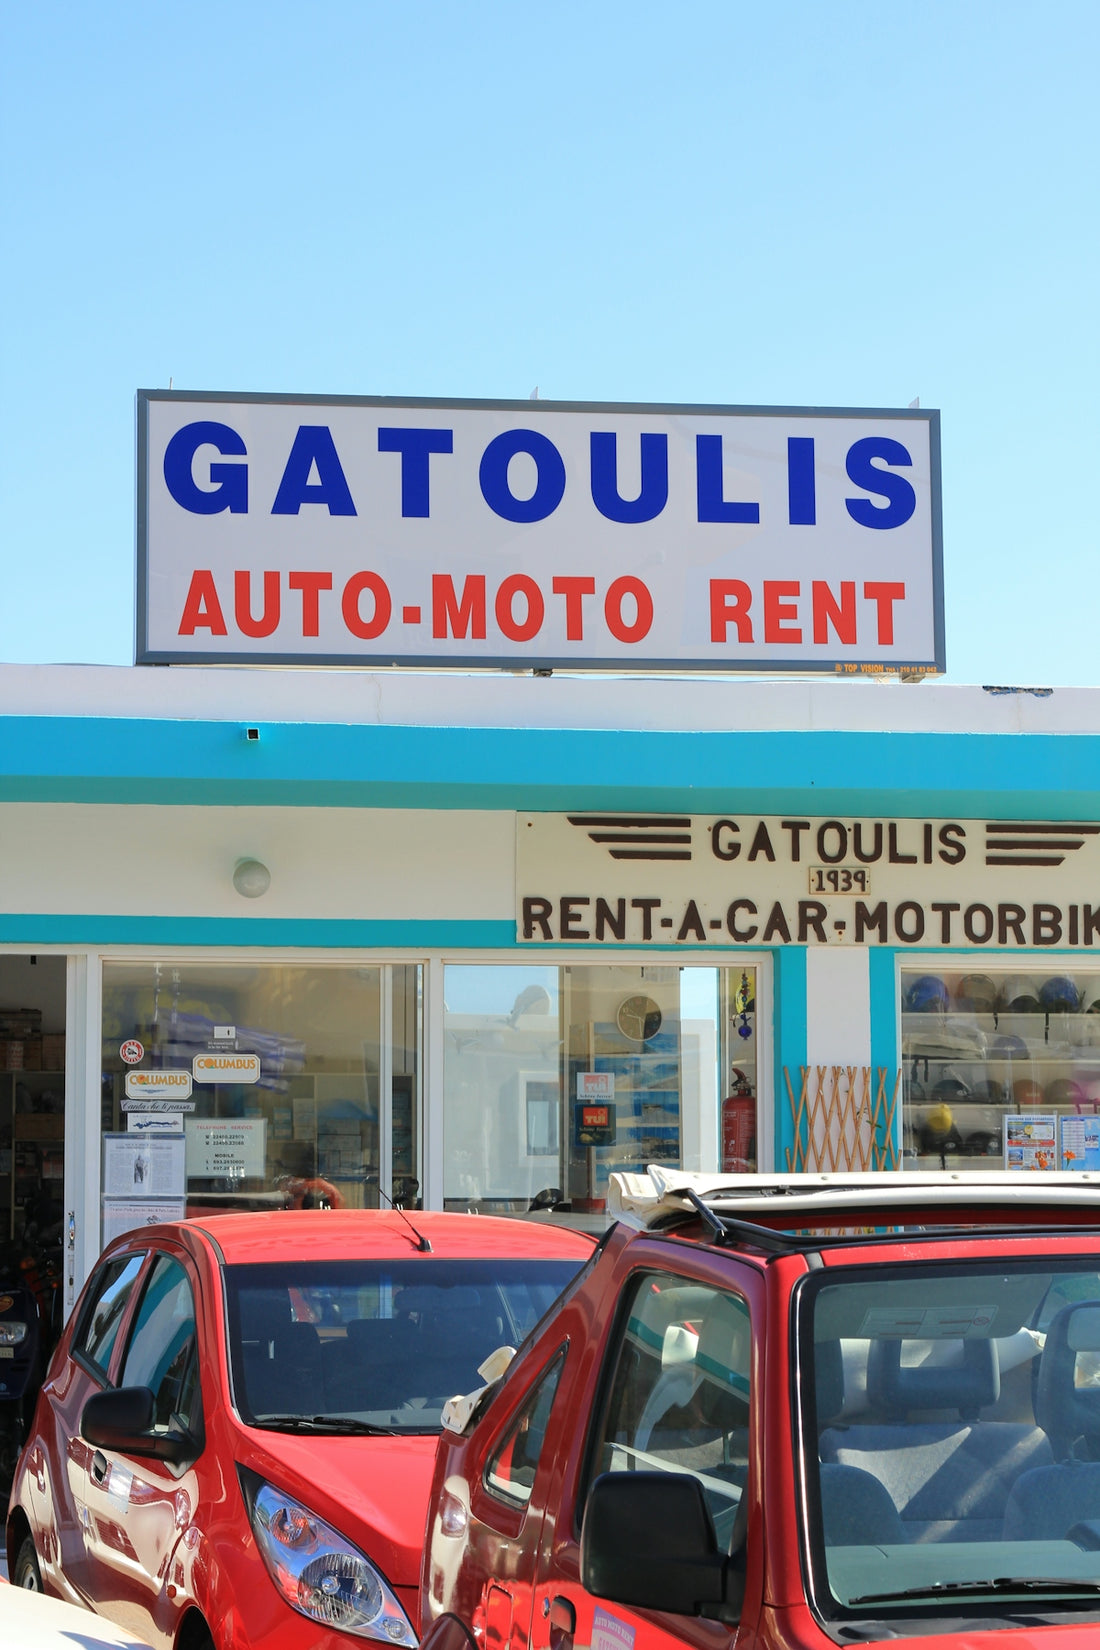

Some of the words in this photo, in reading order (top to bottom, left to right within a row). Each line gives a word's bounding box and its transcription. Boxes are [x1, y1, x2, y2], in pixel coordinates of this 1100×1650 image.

[164, 421, 916, 529] GATOULIS
[179, 570, 653, 643] AUTO-MOTO
[710, 579, 905, 645] RENT
[844, 664, 858, 672] TOP
[860, 664, 884, 672] VISION
[712, 819, 967, 865] GATOULIS
[815, 869, 867, 893] 1939
[197, 1058, 256, 1070] COLUMBUS
[129, 1074, 188, 1086] COLUMBUS
[585, 1112, 605, 1123] TUI
